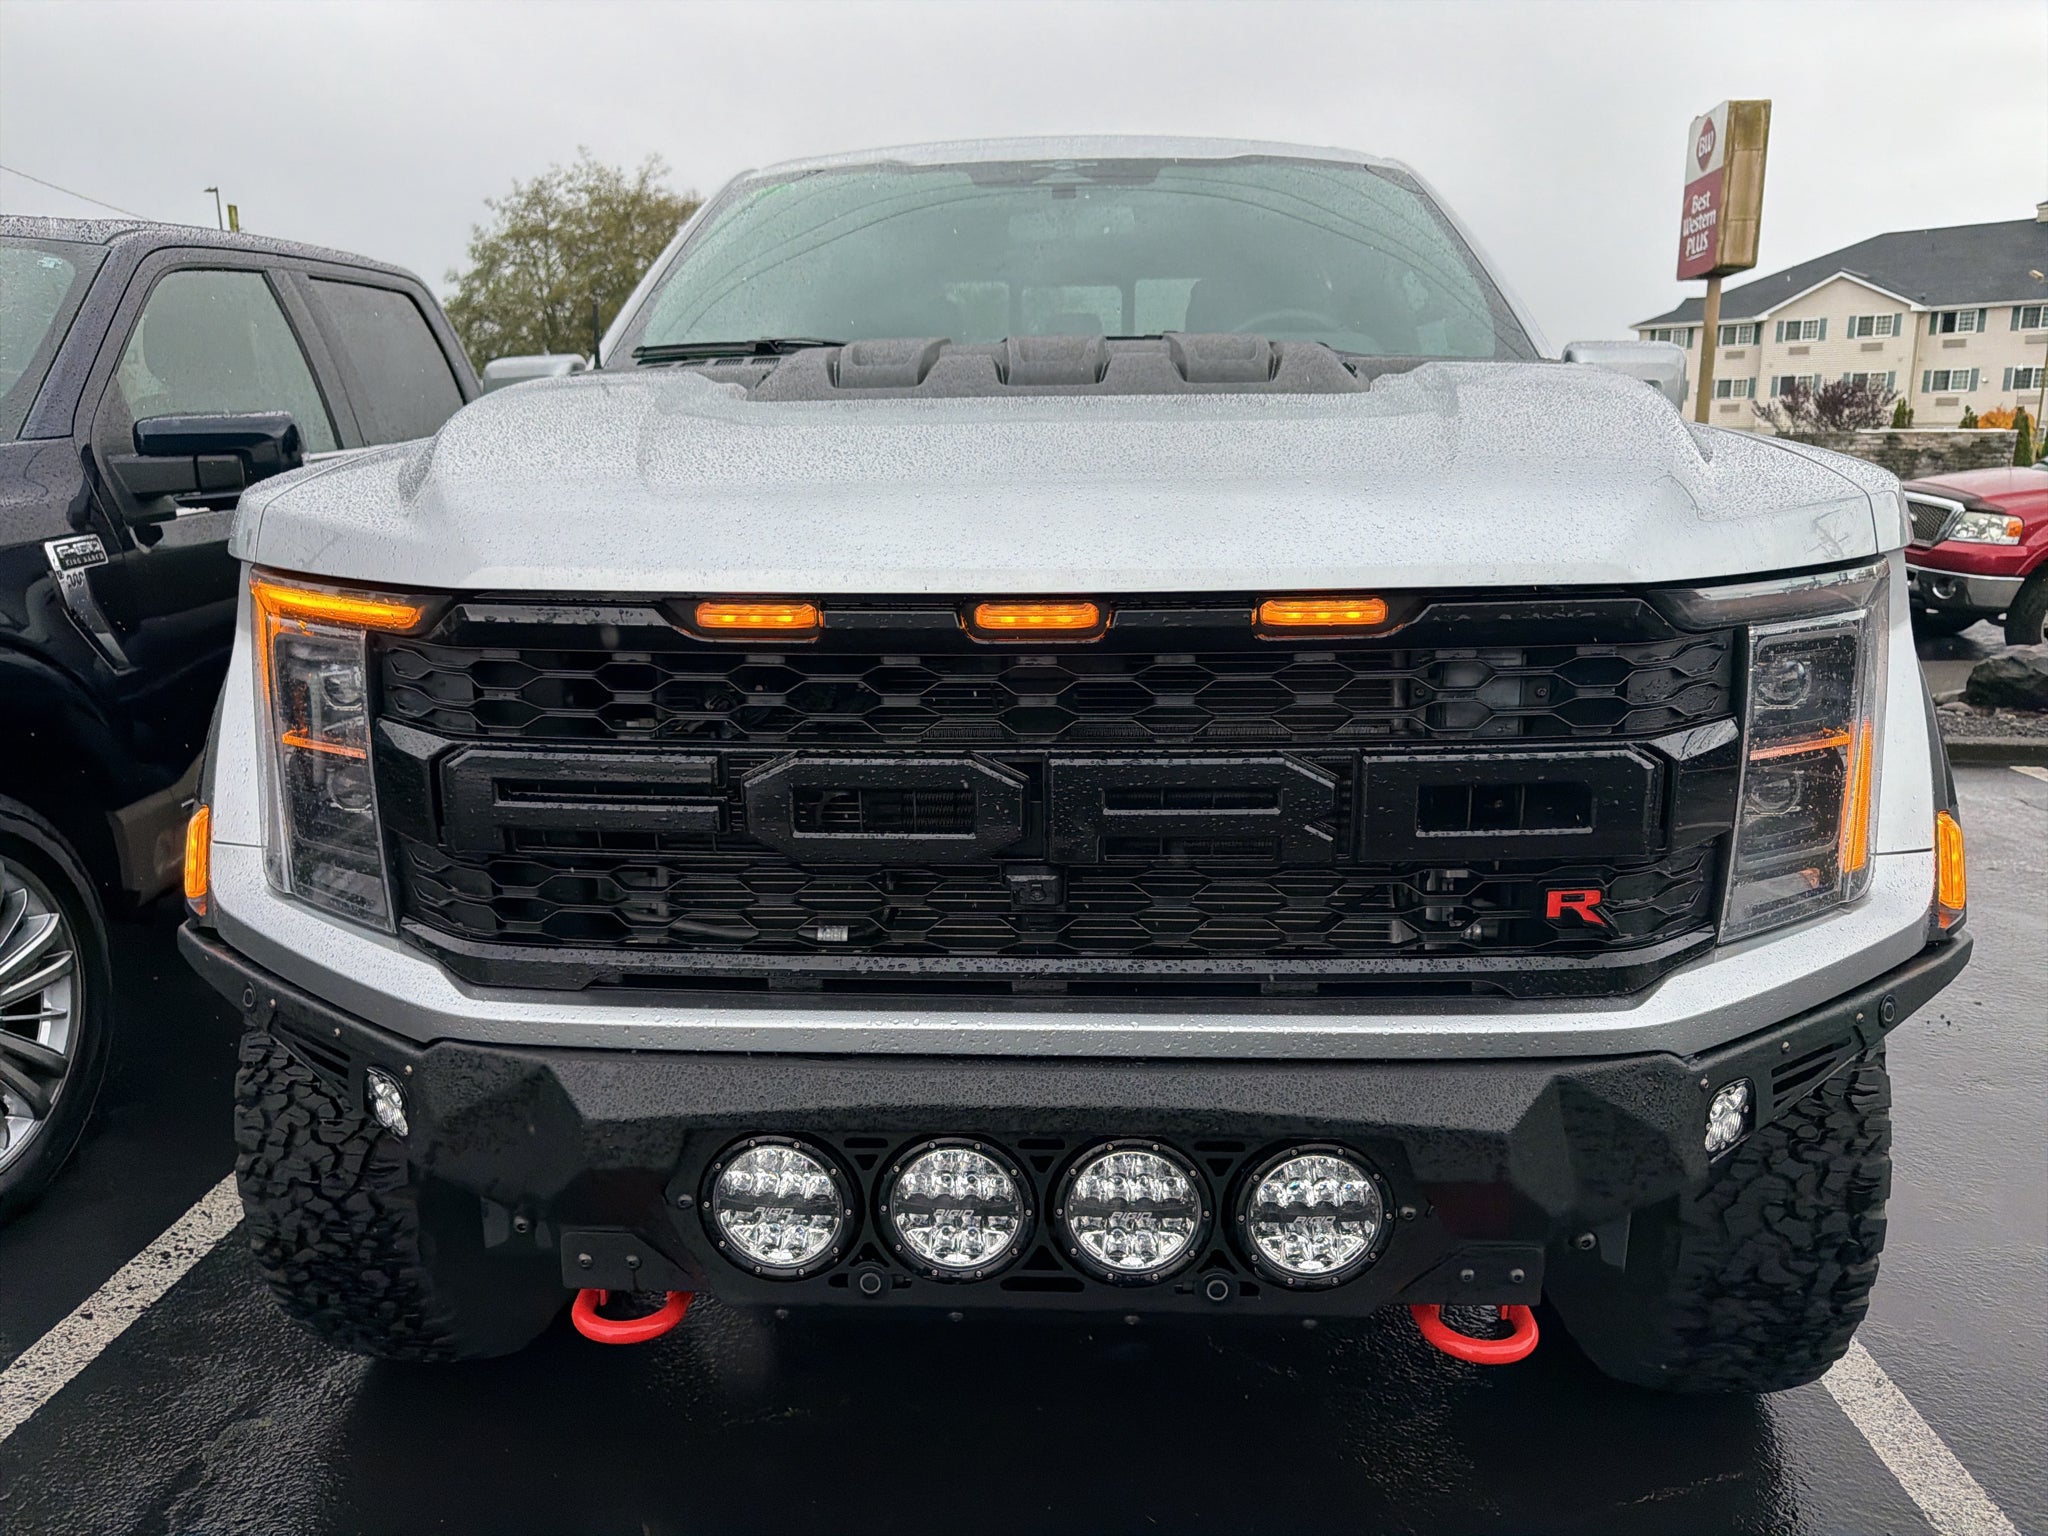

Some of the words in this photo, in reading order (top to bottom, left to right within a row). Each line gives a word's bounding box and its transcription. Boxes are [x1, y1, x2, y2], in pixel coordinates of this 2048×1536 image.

[1691, 190, 1711, 214] Best
[1683, 210, 1716, 236] Western
[1685, 231, 1709, 257] PLUS
[442, 747, 1661, 862] FORD
[1546, 889, 1608, 928] R
[753, 1206, 794, 1216] RIGID
[933, 1208, 974, 1218] RIGID
[1110, 1211, 1152, 1221] RIGID
